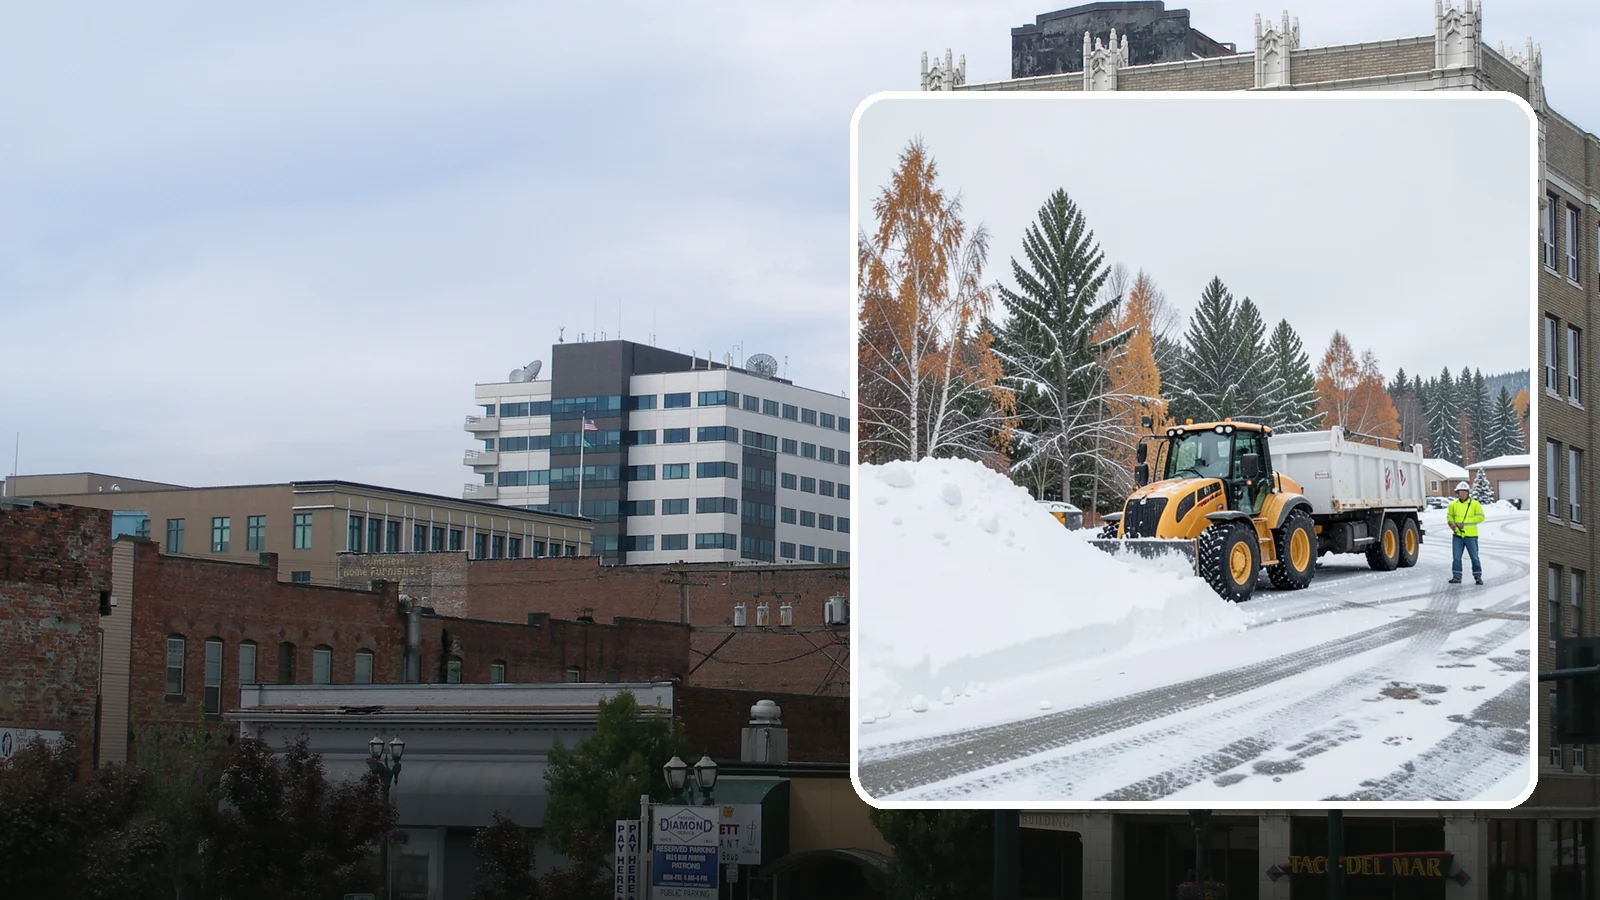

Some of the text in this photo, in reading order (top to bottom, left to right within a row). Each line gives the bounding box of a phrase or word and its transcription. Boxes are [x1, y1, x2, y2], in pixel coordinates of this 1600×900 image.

[343, 566, 428, 577] Home Furnishers
[660, 818, 713, 832] DIAMOND
[1021, 815, 1071, 828] BUILDING
[656, 845, 716, 854] RESERVED PARKING
[616, 824, 625, 893] PAY HERE
[628, 824, 637, 893] PAY HERE
[1289, 855, 1442, 877] TAC DEL MAR
[660, 889, 710, 898] PUBLIC PARKING
